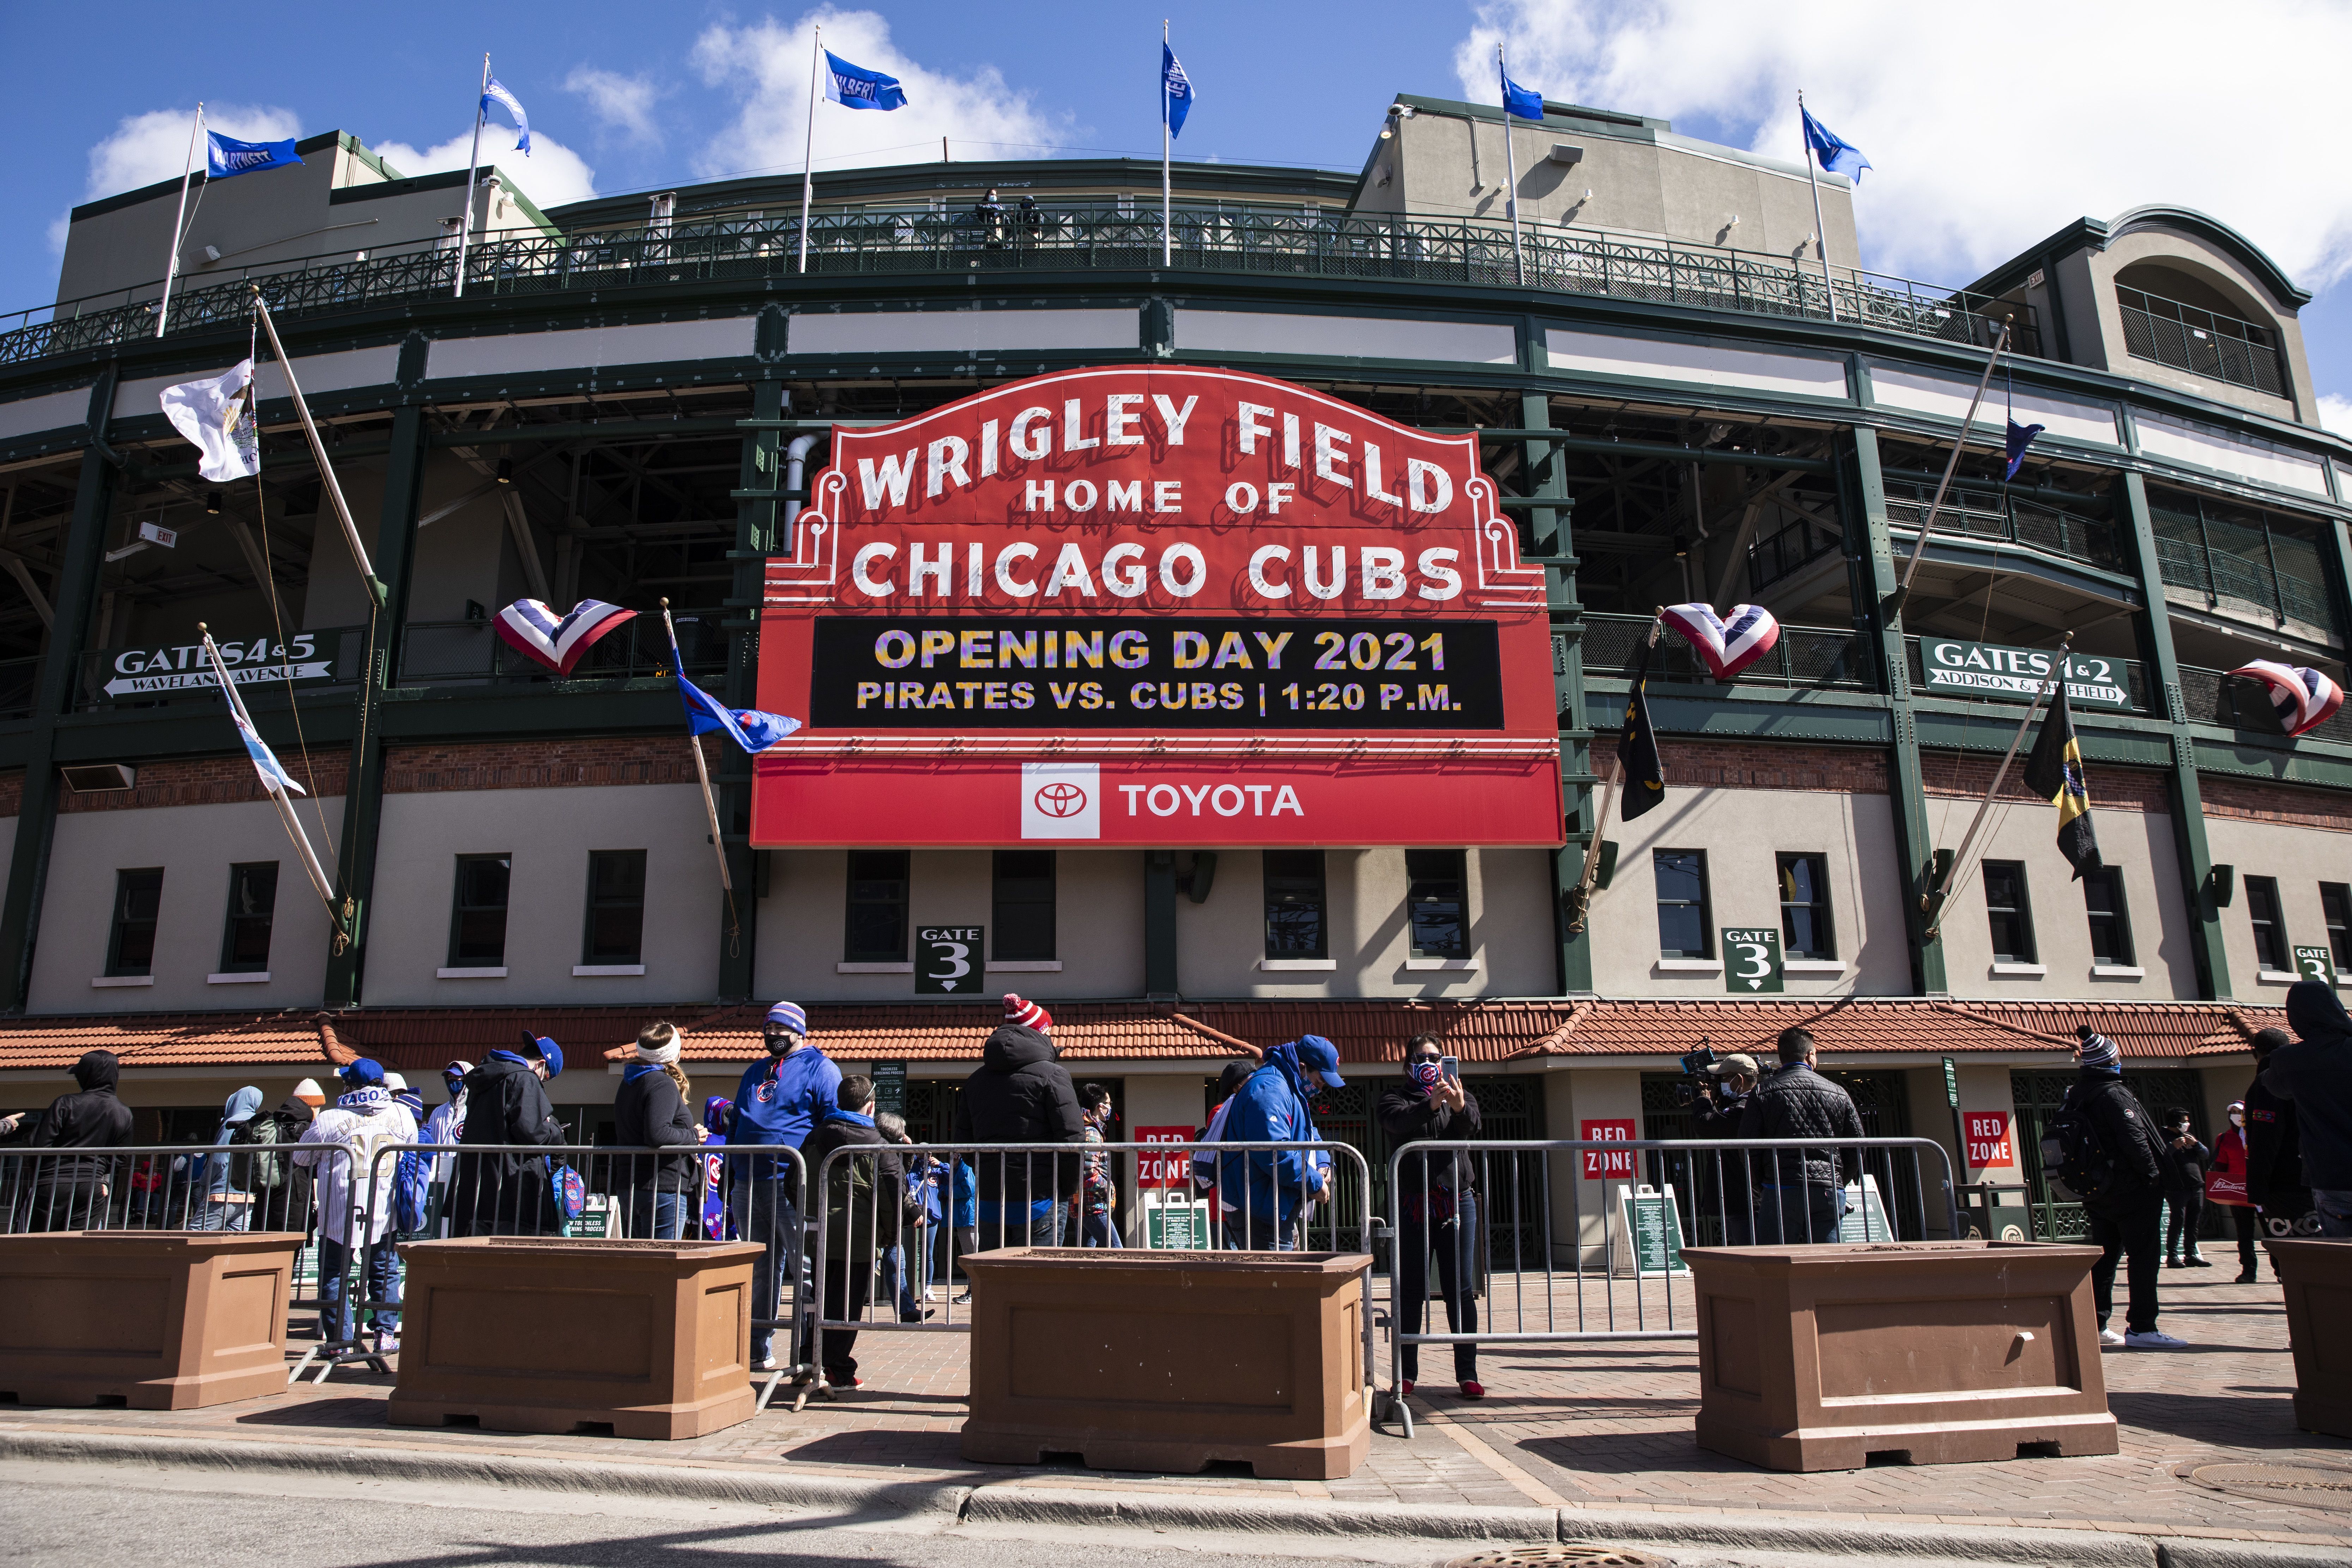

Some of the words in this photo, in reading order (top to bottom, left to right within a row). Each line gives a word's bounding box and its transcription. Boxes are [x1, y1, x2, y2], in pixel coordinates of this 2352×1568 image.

[214, 147, 272, 170] HARTNETT
[2030, 272, 2042, 285] EXIT
[858, 394, 1199, 510] WRIGLEY
[1239, 401, 1453, 514] FIELD
[1026, 479, 1182, 513] HOME
[1225, 482, 1295, 514] OF
[157, 530, 173, 544] EXIT
[852, 542, 1207, 598] CHICAGO
[1248, 544, 1462, 601] CUBS
[115, 642, 244, 674] GATES
[875, 630, 1149, 669] OPENING
[1173, 631, 1294, 670] DAY
[1314, 632, 1444, 670] 2021
[1934, 643, 2051, 676] GATES
[234, 665, 304, 683] AVENUE
[1938, 671, 2013, 690] ADDISON
[2020, 679, 2031, 691] &
[2037, 681, 2117, 700] SHFFIELD
[857, 682, 1035, 709] PIRATES
[1048, 682, 1115, 709] VS.
[1130, 682, 1244, 709] CUBS
[1281, 682, 1365, 711] 1:20
[1379, 684, 1462, 710] P.M.
[1119, 783, 1304, 817] TOYOTA
[921, 929, 979, 940] GATE
[1726, 931, 1775, 942] GATE
[929, 942, 970, 979] 3
[1736, 943, 1771, 978] 3
[2296, 948, 2328, 958] GATE
[2303, 959, 2329, 985] 3
[337, 1090, 379, 1106] ICAGO
[337, 1114, 402, 1135] CHAMPIONS
[1592, 1127, 1626, 1141] RED
[1972, 1119, 2001, 1136] RED
[1147, 1134, 1184, 1153] RED
[1970, 1142, 2010, 1160] ZONE
[348, 1133, 395, 1179] 16
[1588, 1152, 1631, 1171] ZONE
[1139, 1160, 1190, 1179] ZONE
[2214, 1181, 2246, 1191] Budwei
